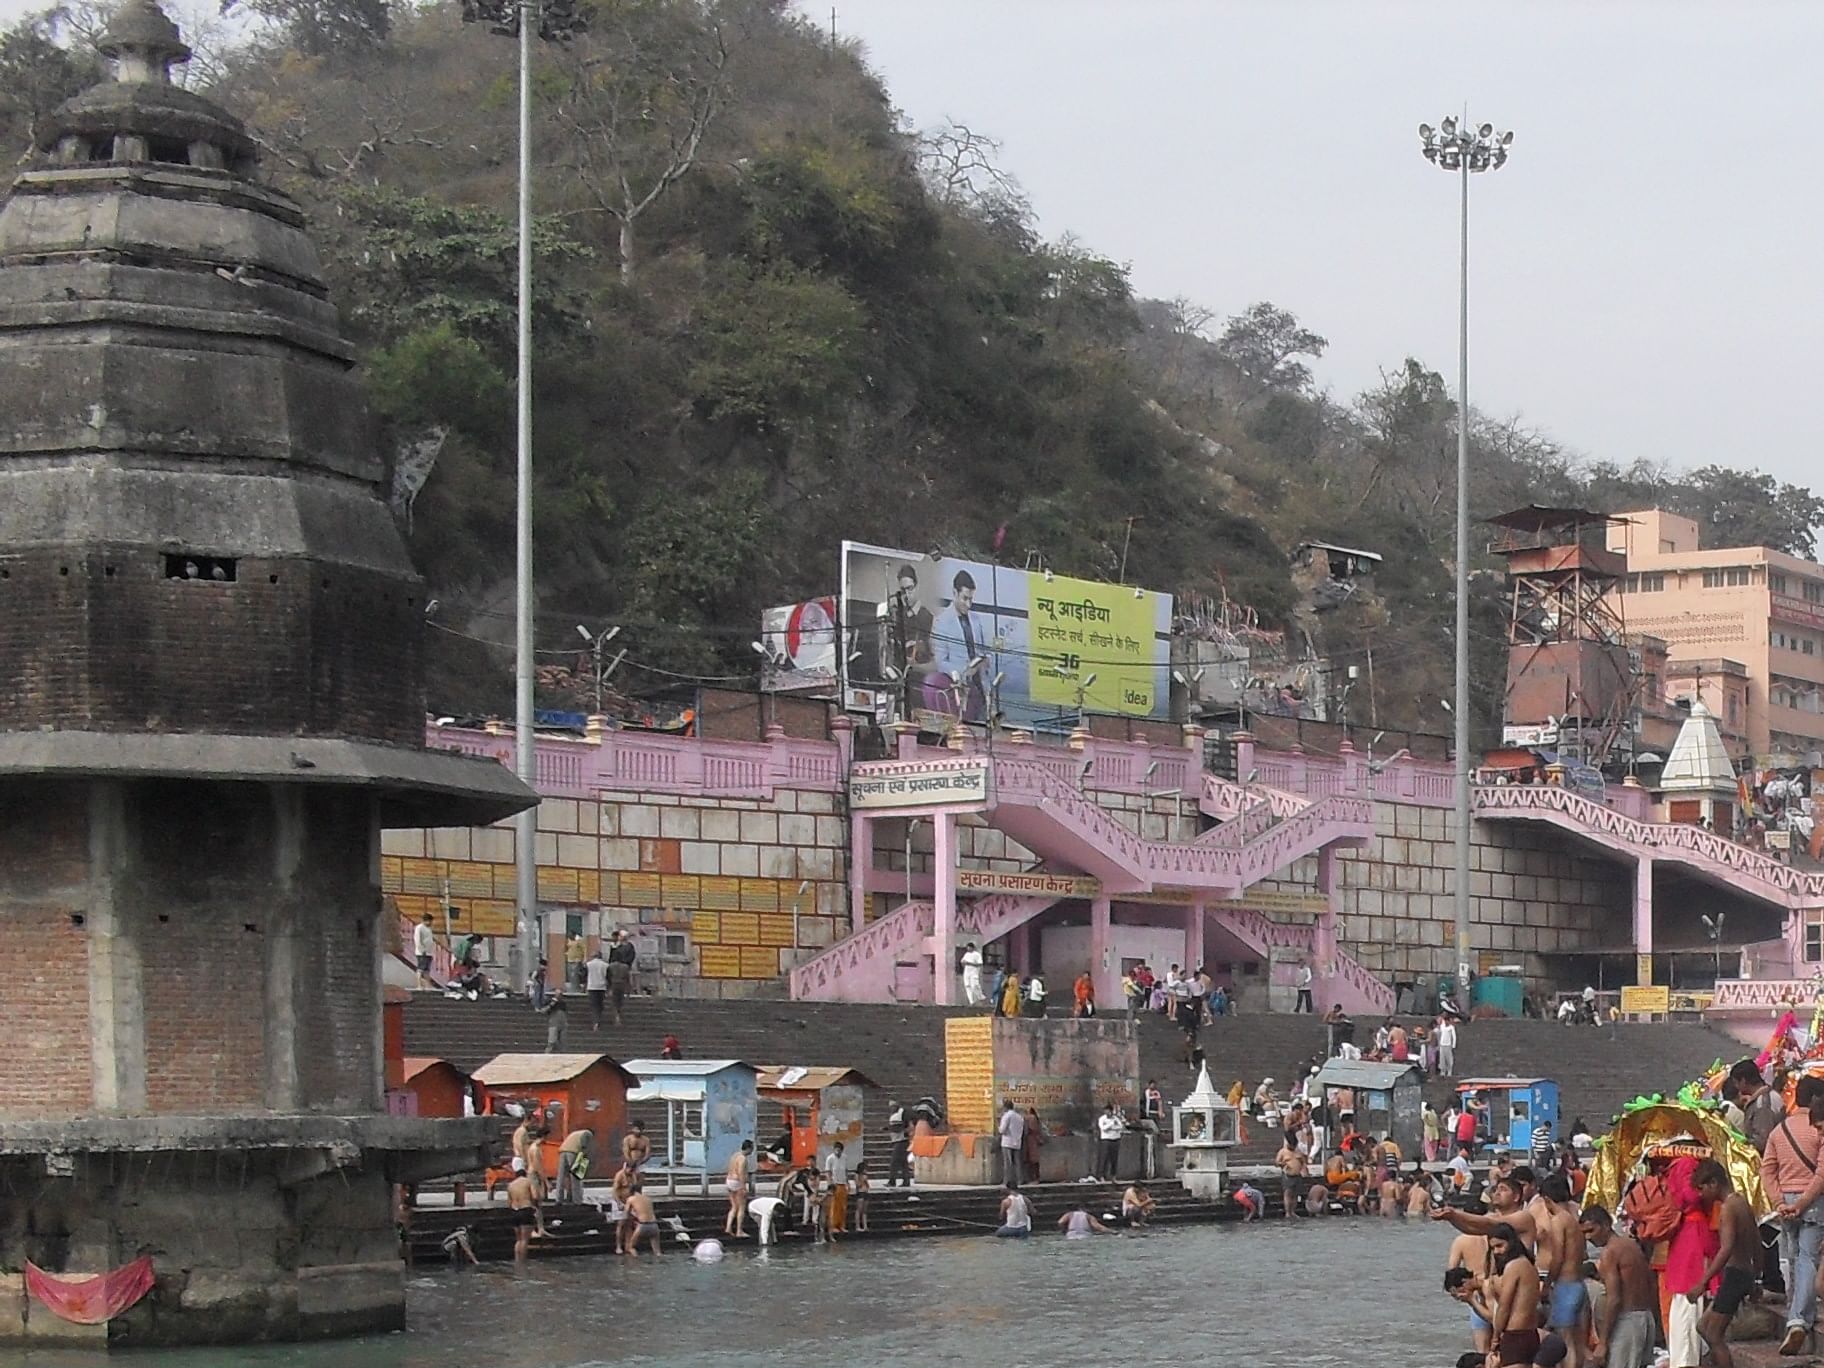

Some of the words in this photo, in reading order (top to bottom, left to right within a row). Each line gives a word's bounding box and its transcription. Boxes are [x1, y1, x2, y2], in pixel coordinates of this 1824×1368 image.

[1037, 598, 1058, 621] न्यू
[1058, 598, 1110, 623] आइडिया
[851, 782, 886, 801] सूचना
[960, 872, 995, 888] सूचना
